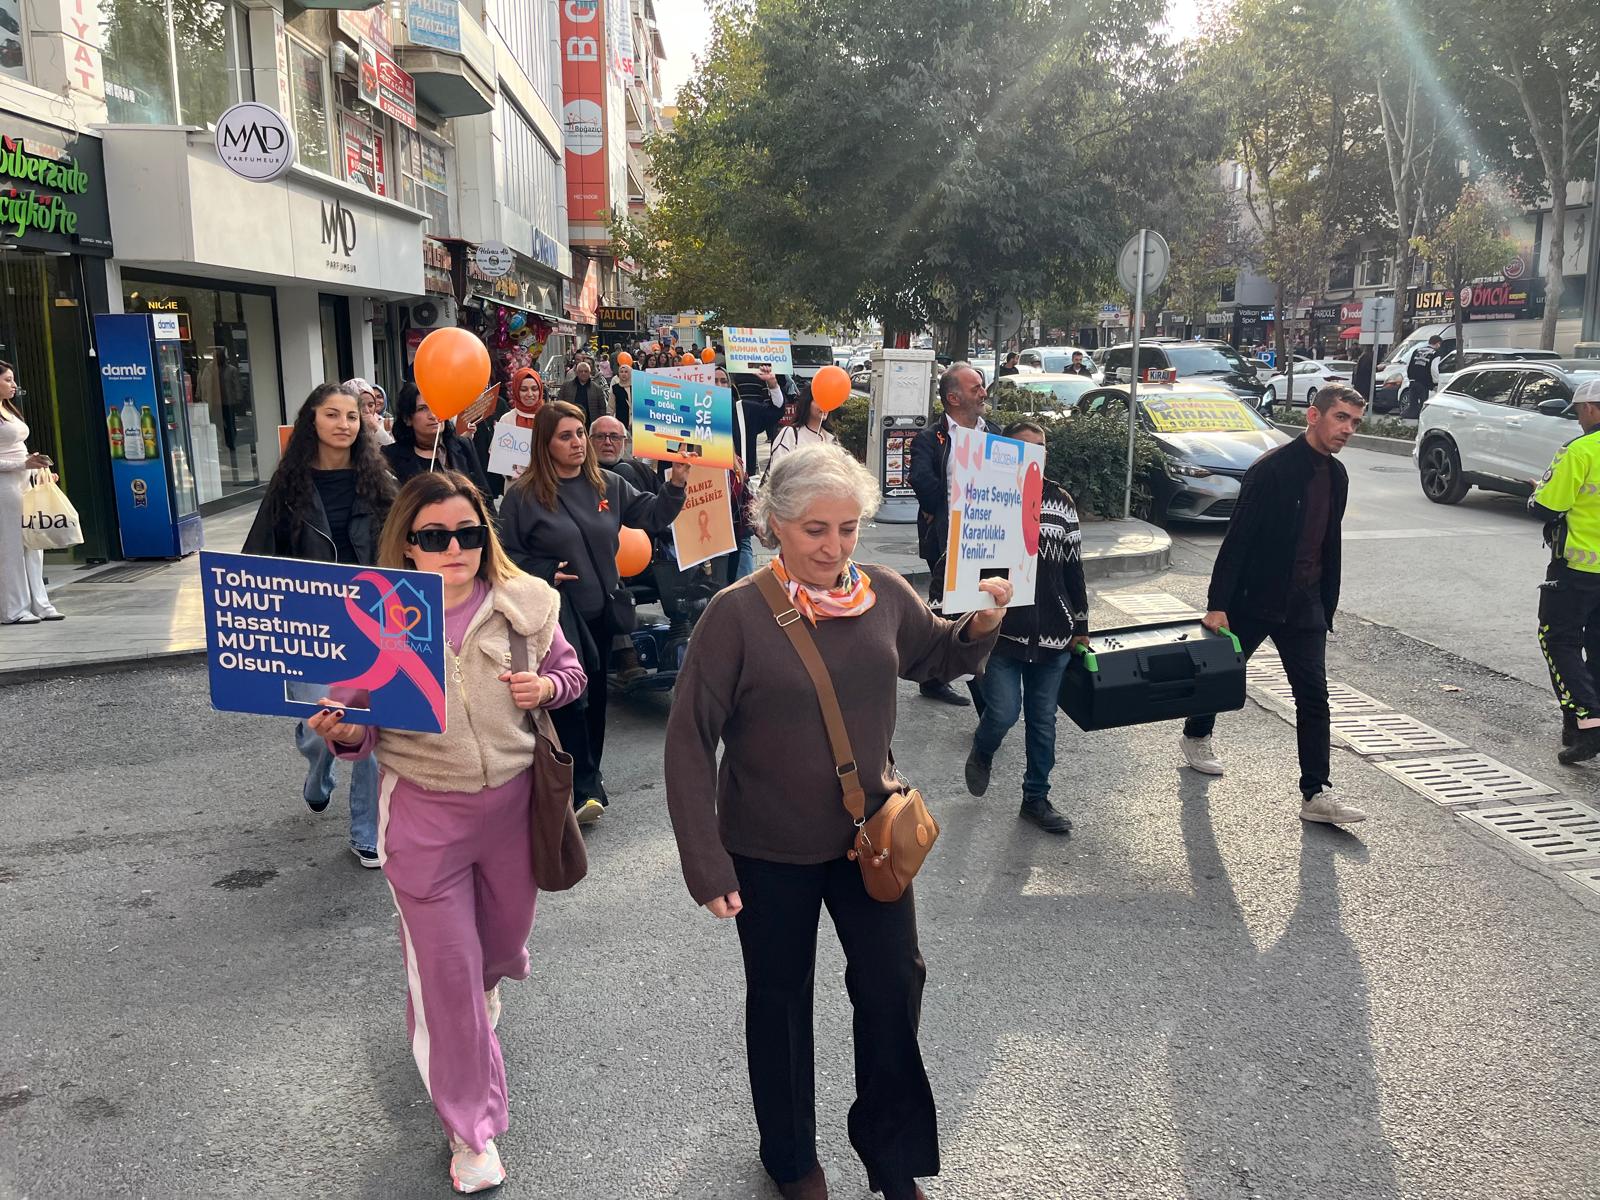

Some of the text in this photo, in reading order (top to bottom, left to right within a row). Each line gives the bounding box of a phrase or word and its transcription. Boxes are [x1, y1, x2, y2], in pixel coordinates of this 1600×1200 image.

[222, 121, 285, 155] MAD
[228, 156, 280, 164] PARFUMEUR
[321, 199, 357, 257] MAD
[326, 260, 357, 273] PARFUMEUR
[1416, 292, 1442, 309] USTA
[599, 309, 634, 320] TATLICI
[1242, 317, 1257, 325] Spor
[158, 320, 176, 329] damla
[760, 336, 769, 344] İLE
[729, 345, 785, 354] RUHUM GÜÇLÜ
[763, 354, 787, 363] GÜÇLÜ
[1261, 353, 1272, 362] P
[102, 363, 146, 376] damla
[650, 386, 682, 400] birgün
[657, 401, 676, 410] DEĞİL
[649, 410, 684, 425] hergün
[685, 480, 713, 494] ALNIZ
[966, 483, 1022, 508] Hayat Sevgiyle,
[964, 504, 992, 521] Kanser
[963, 523, 1005, 540] Kararlılıkla
[961, 543, 996, 560] Yenilir...!
[211, 567, 361, 600] Tohumumuz
[214, 589, 285, 613] UMUT
[216, 611, 331, 639] Hasatımız
[218, 632, 347, 661] MUTLULUK
[219, 653, 304, 677] Olsun...
